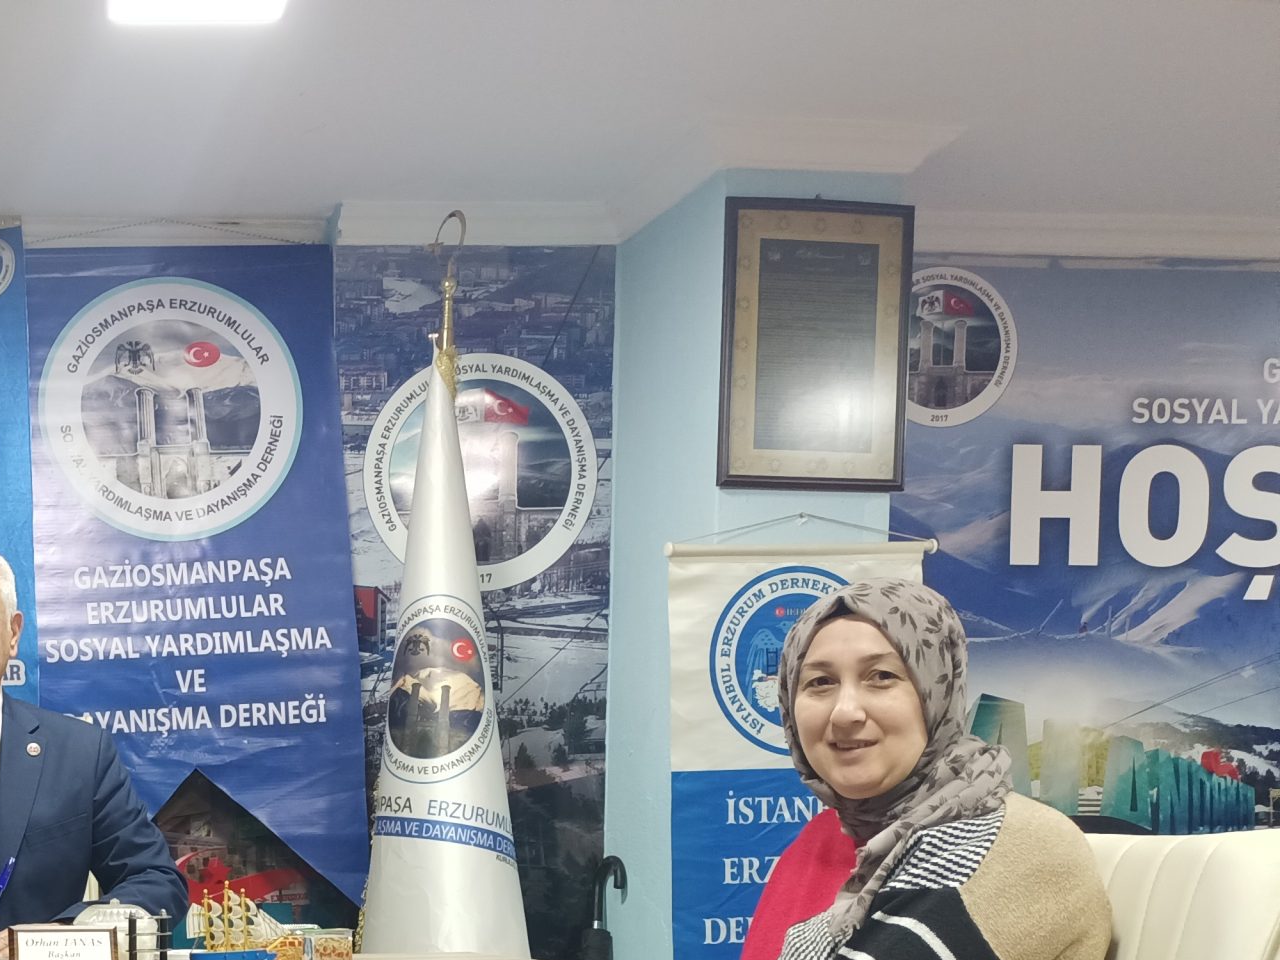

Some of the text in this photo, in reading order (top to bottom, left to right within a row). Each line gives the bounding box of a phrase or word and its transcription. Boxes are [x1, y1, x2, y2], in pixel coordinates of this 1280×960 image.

[67, 298, 270, 374] GAZİOSMANPAŞA ERZURUMLULAR
[455, 363, 488, 376] OSYAL
[491, 363, 560, 406] YARDIMLAŞMA
[380, 380, 430, 440] ERZURUMLU
[558, 402, 571, 419] VE
[1131, 397, 1248, 425] SOSYAL
[566, 418, 587, 480] DAYANIŞMA
[175, 509, 194, 522] VE
[195, 472, 262, 518] DAYANIŞMA
[256, 415, 284, 472] DERNEĞİ
[373, 443, 397, 532] GAZİOSMANPAŞA
[73, 557, 292, 590] GAZİOSMANPAŞA
[479, 572, 492, 583] 17
[86, 593, 287, 625] ERZURUMLULAR
[45, 626, 332, 663] SOSYAL YARDIMLAŞMA
[720, 577, 837, 736] İSTANBUL ERZURUM DERNEK
[175, 668, 207, 694] VE
[220, 693, 327, 729] DERNEĞİ
[417, 765, 429, 775] VE
[431, 744, 481, 775] DAYANIŞMA
[404, 821, 421, 836] VE
[422, 823, 494, 847] DAYANIŞMA
